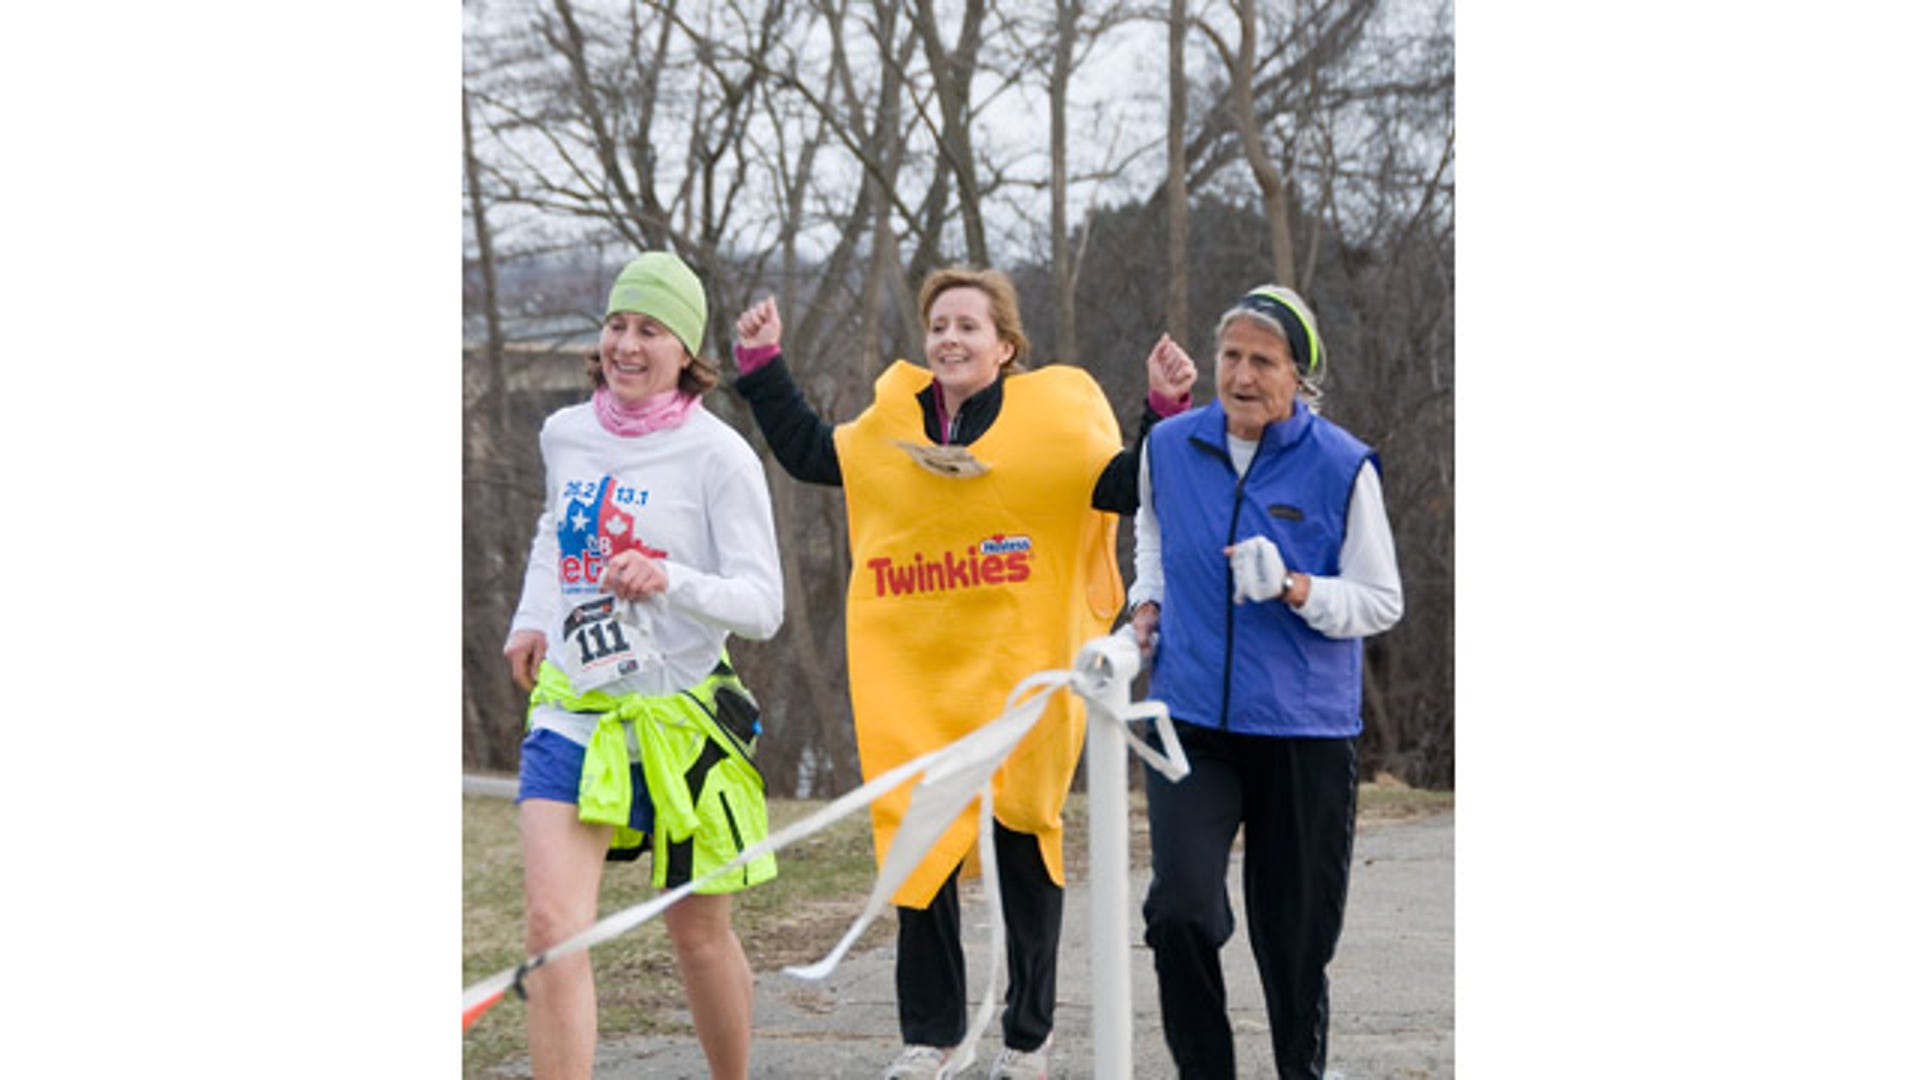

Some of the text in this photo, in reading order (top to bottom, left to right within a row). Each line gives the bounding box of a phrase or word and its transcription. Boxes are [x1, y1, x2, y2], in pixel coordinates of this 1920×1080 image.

[616, 487, 649, 506] 13.1
[866, 545, 1031, 598] Twinkies
[576, 619, 631, 665] 111
